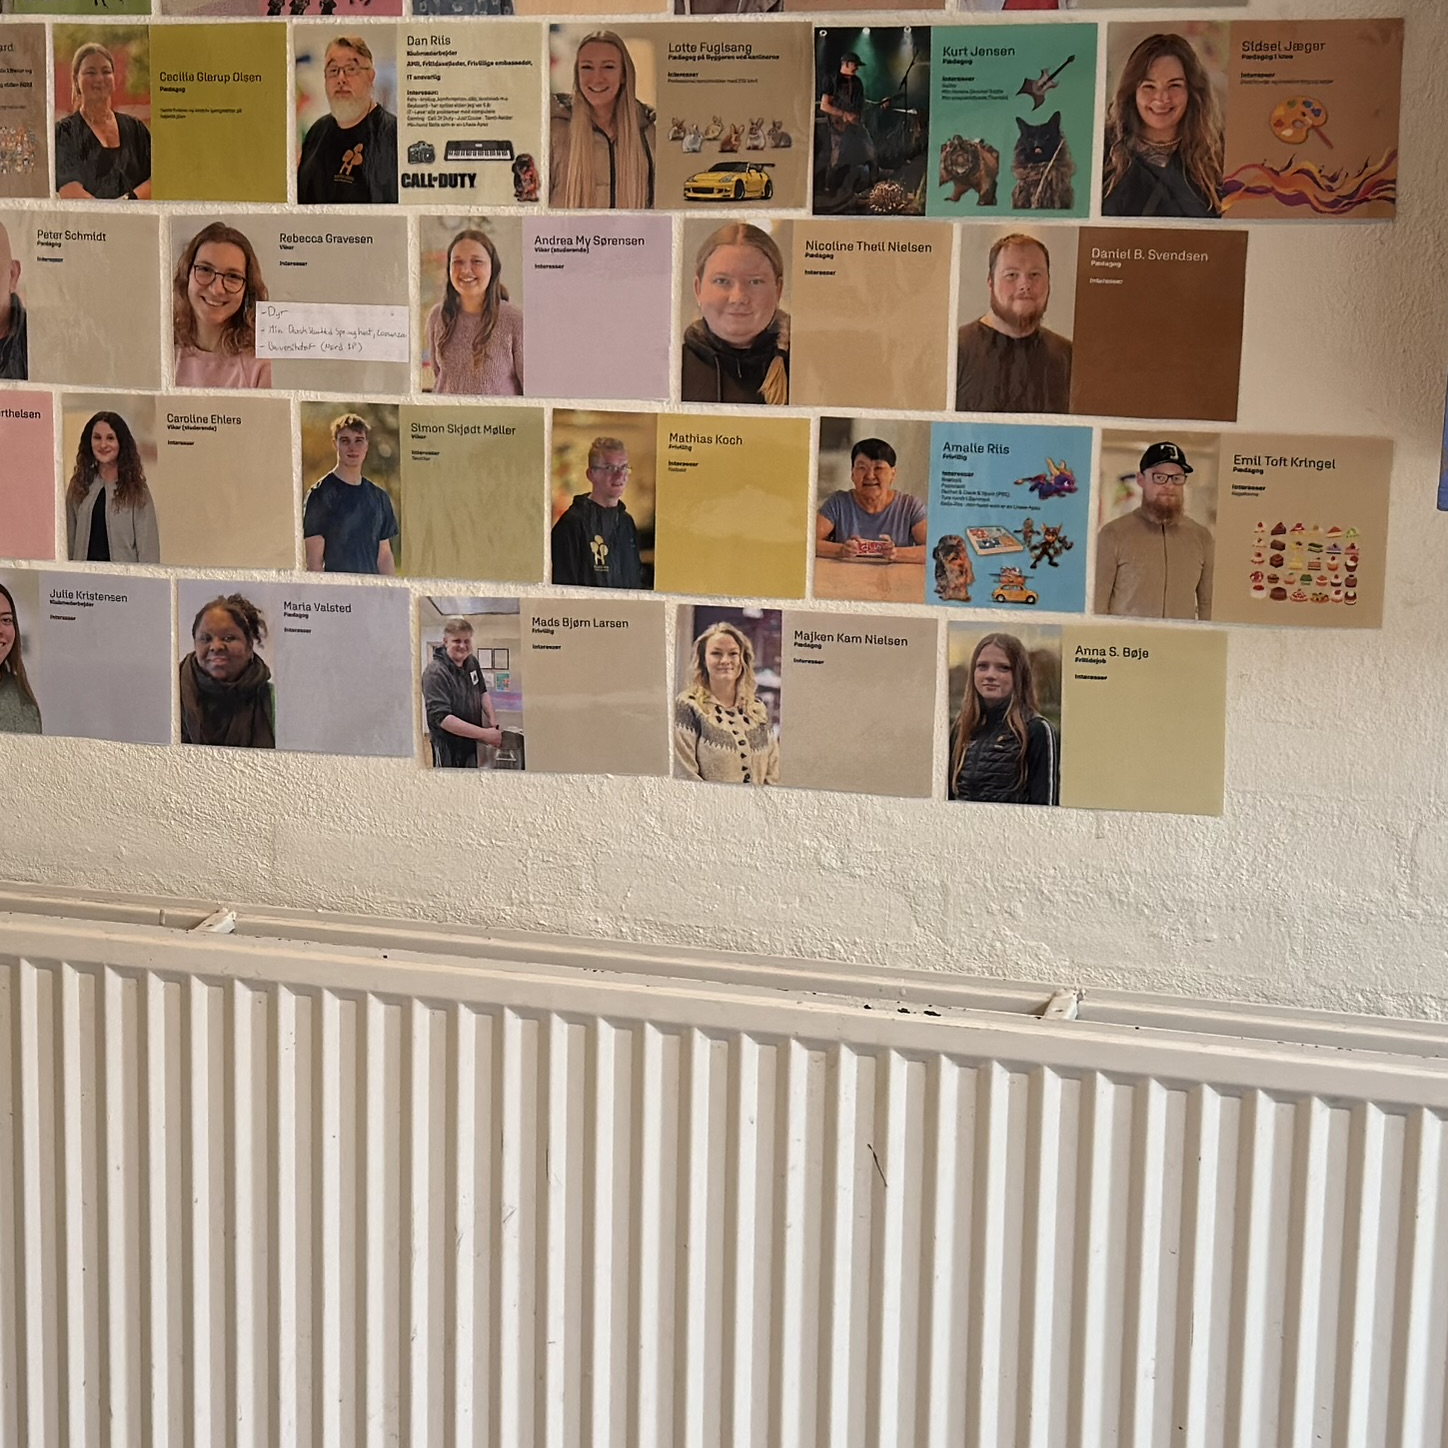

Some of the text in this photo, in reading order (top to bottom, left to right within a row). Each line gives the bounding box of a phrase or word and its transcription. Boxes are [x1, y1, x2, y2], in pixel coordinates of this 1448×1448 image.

[407, 35, 451, 46] Dan Riis
[669, 42, 752, 55] Lotte Fuglsang
[943, 47, 1015, 57] Kurt Jensen
[1242, 41, 1325, 54] Sidsel Jæger
[160, 72, 261, 84] Cecilie Glerup Olsen
[401, 173, 477, 188] CALL DUTY
[37, 230, 106, 241] Peter Schmidt
[280, 233, 373, 244] Rebecca Gravesen
[534, 236, 645, 247] Andrea My Sørensen
[806, 241, 932, 252] Nicoline Theil Nielsen
[1091, 248, 1208, 262] Daniel B. Svendsen
[167, 414, 241, 425] Caroline Ehlers
[411, 423, 516, 436] Simon Skjødt Møller
[669, 433, 742, 445] Mathias Koch
[943, 442, 1009, 454] Amalie Riis
[1234, 455, 1335, 471] Emil Toft Kringel
[50, 590, 127, 602] Julie Kristensen
[284, 601, 351, 613] Maria Valsted
[532, 617, 628, 629] Mads Bjørn Larsen
[794, 631, 908, 646] Majken Kam Nielsen
[1075, 646, 1149, 659] Anna S. Bøje
